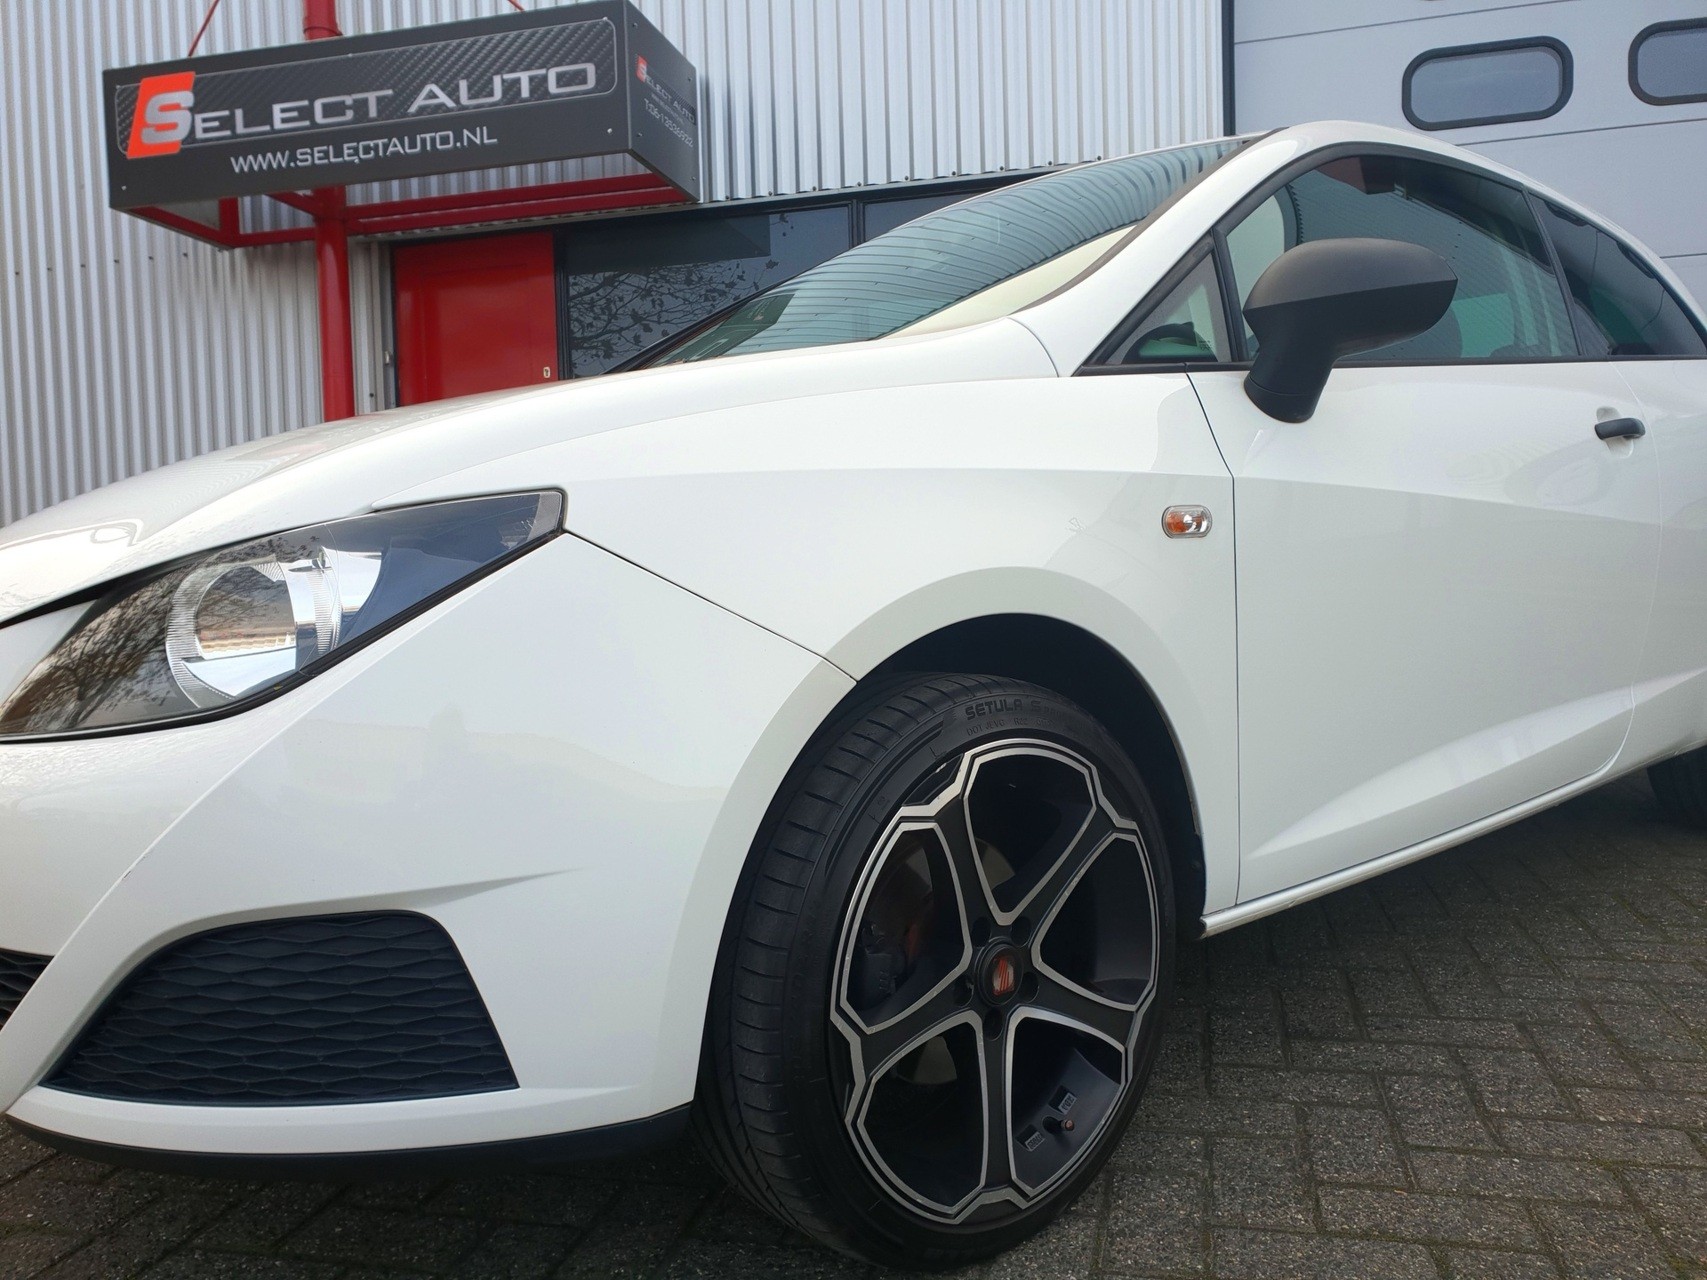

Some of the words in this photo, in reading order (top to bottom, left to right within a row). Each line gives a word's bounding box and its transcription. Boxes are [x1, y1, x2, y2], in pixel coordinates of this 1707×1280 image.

[140, 88, 393, 146] SELECT
[407, 62, 596, 112] AUTO
[230, 130, 498, 174] WWW.SELECTAUTO.NL
[965, 698, 1023, 720] SETULA
